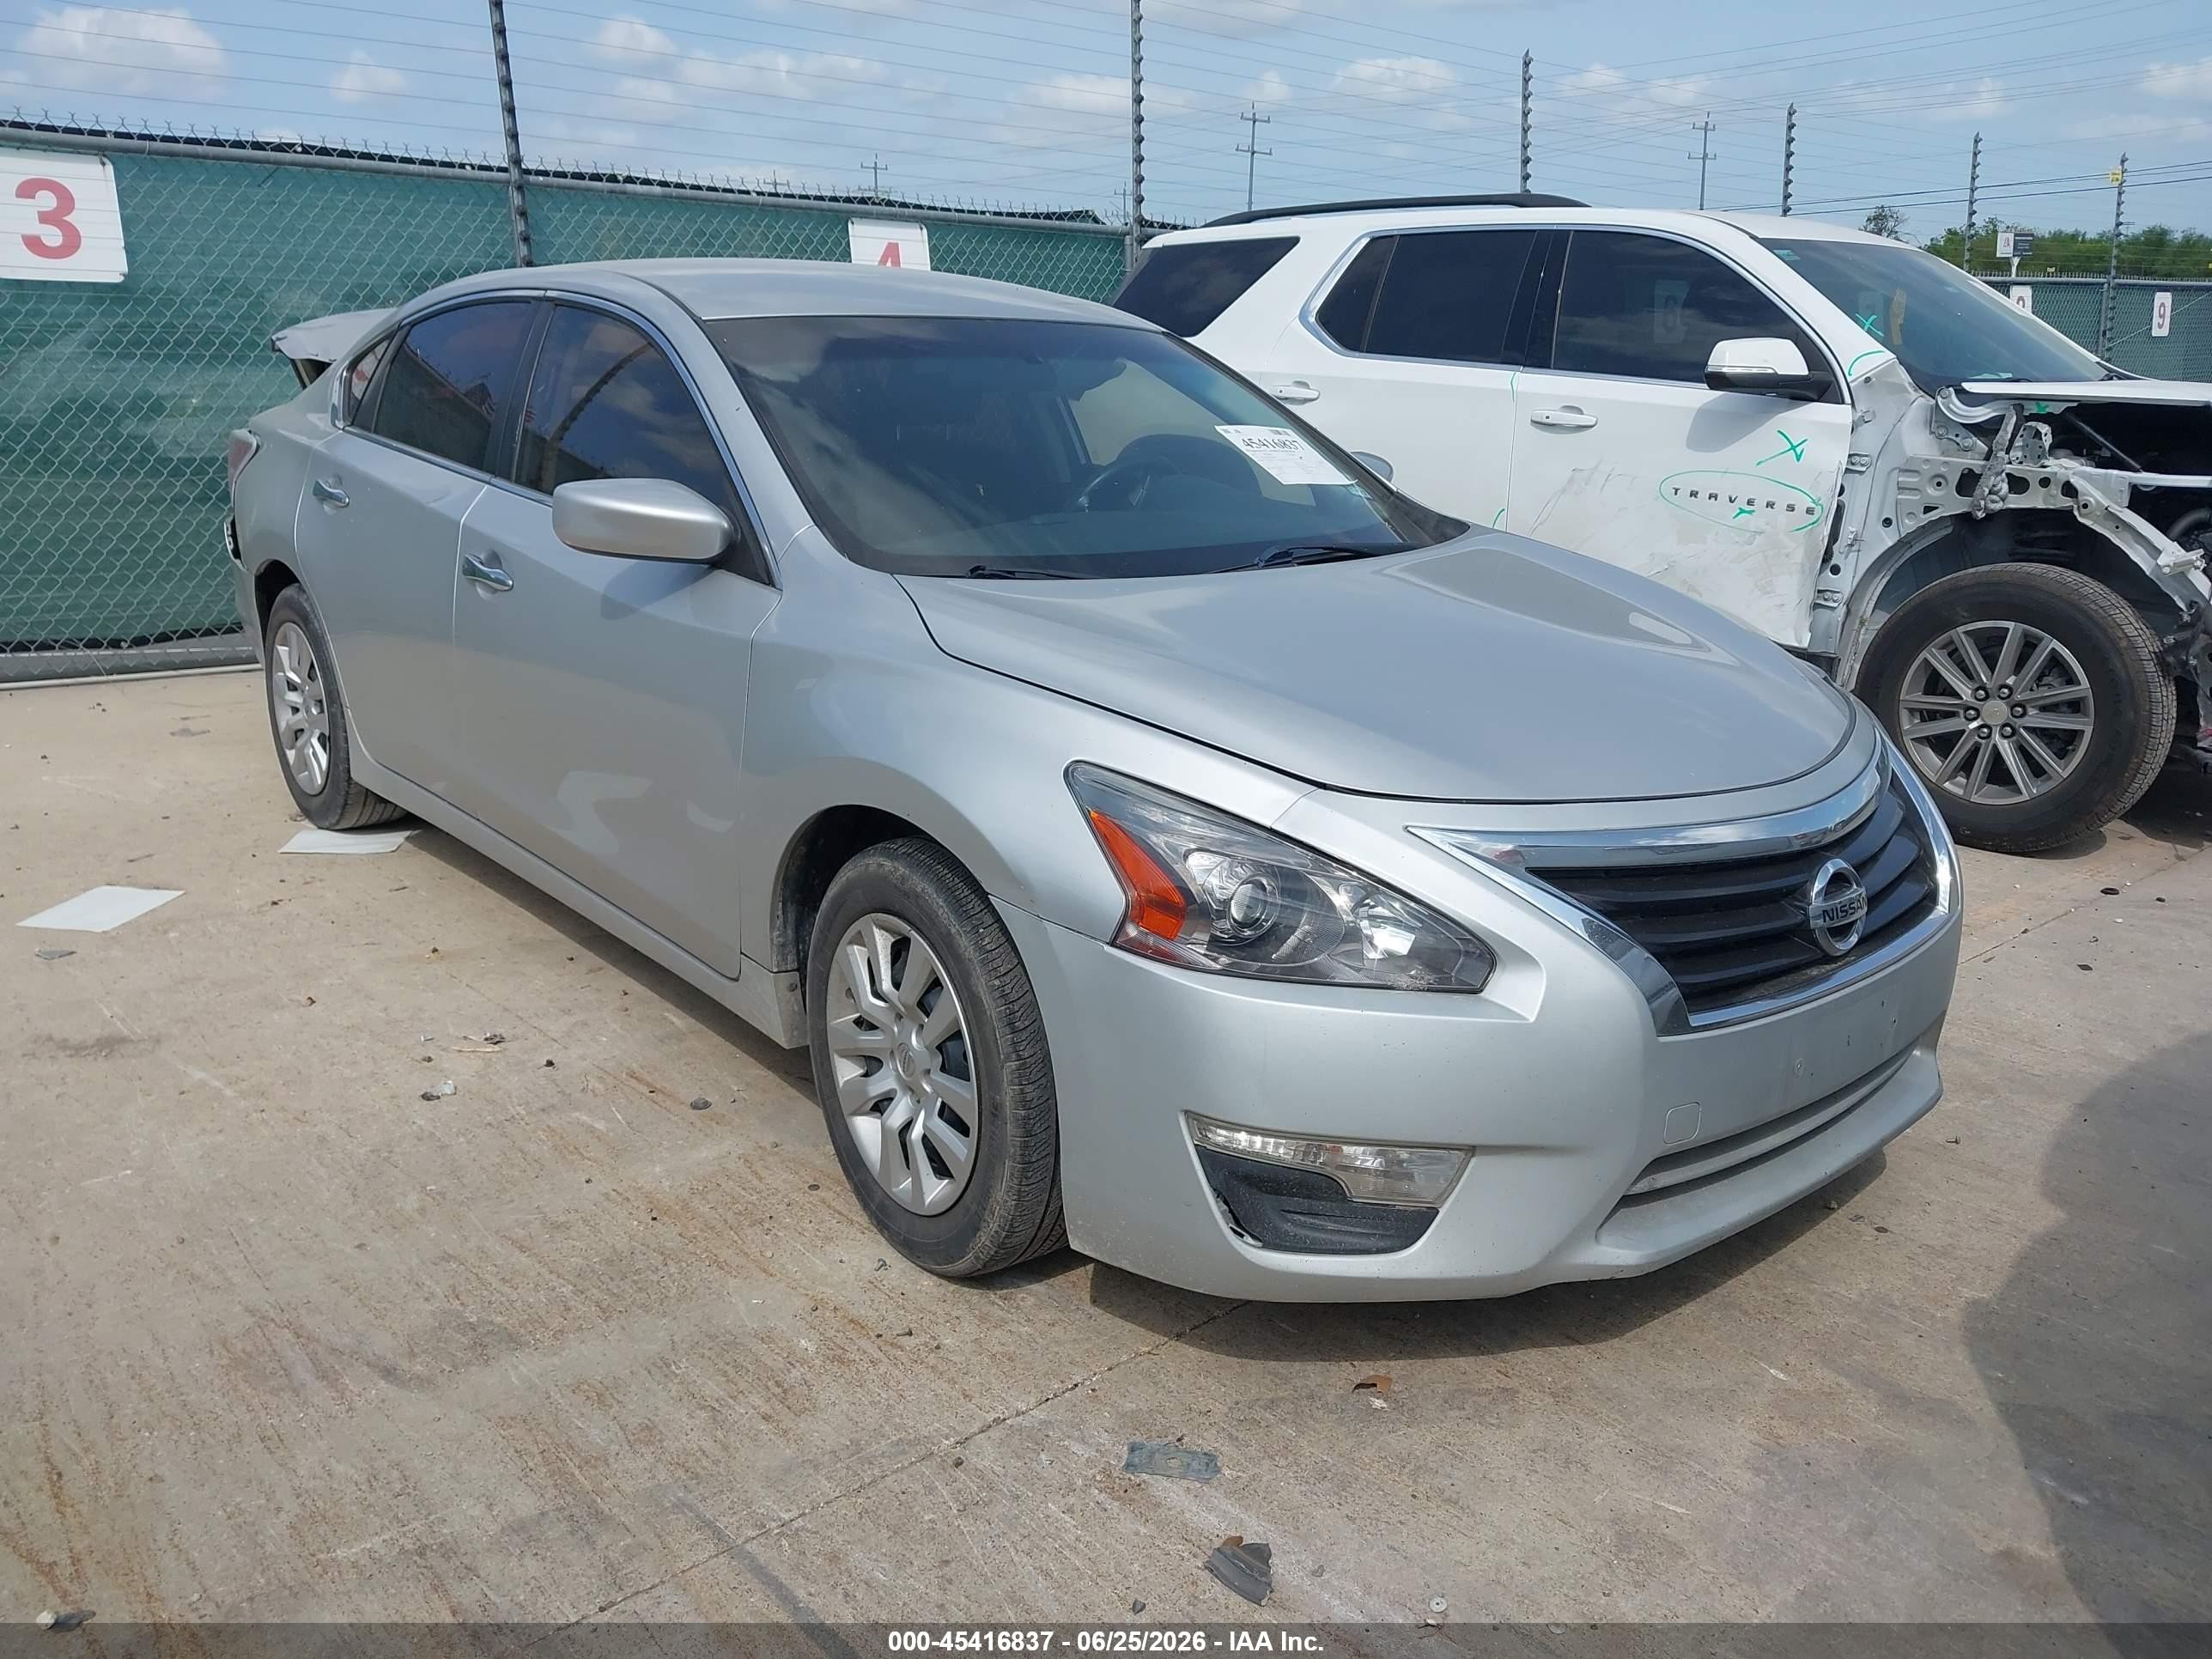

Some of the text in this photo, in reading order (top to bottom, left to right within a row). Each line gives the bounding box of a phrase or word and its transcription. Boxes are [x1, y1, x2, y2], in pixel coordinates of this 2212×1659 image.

[15, 178, 82, 260] 3
[2157, 301, 2167, 330] 9
[1242, 438, 1304, 451] 45416837
[1672, 487, 1816, 515] TRAVERSE
[1821, 897, 1867, 923] NISSAN
